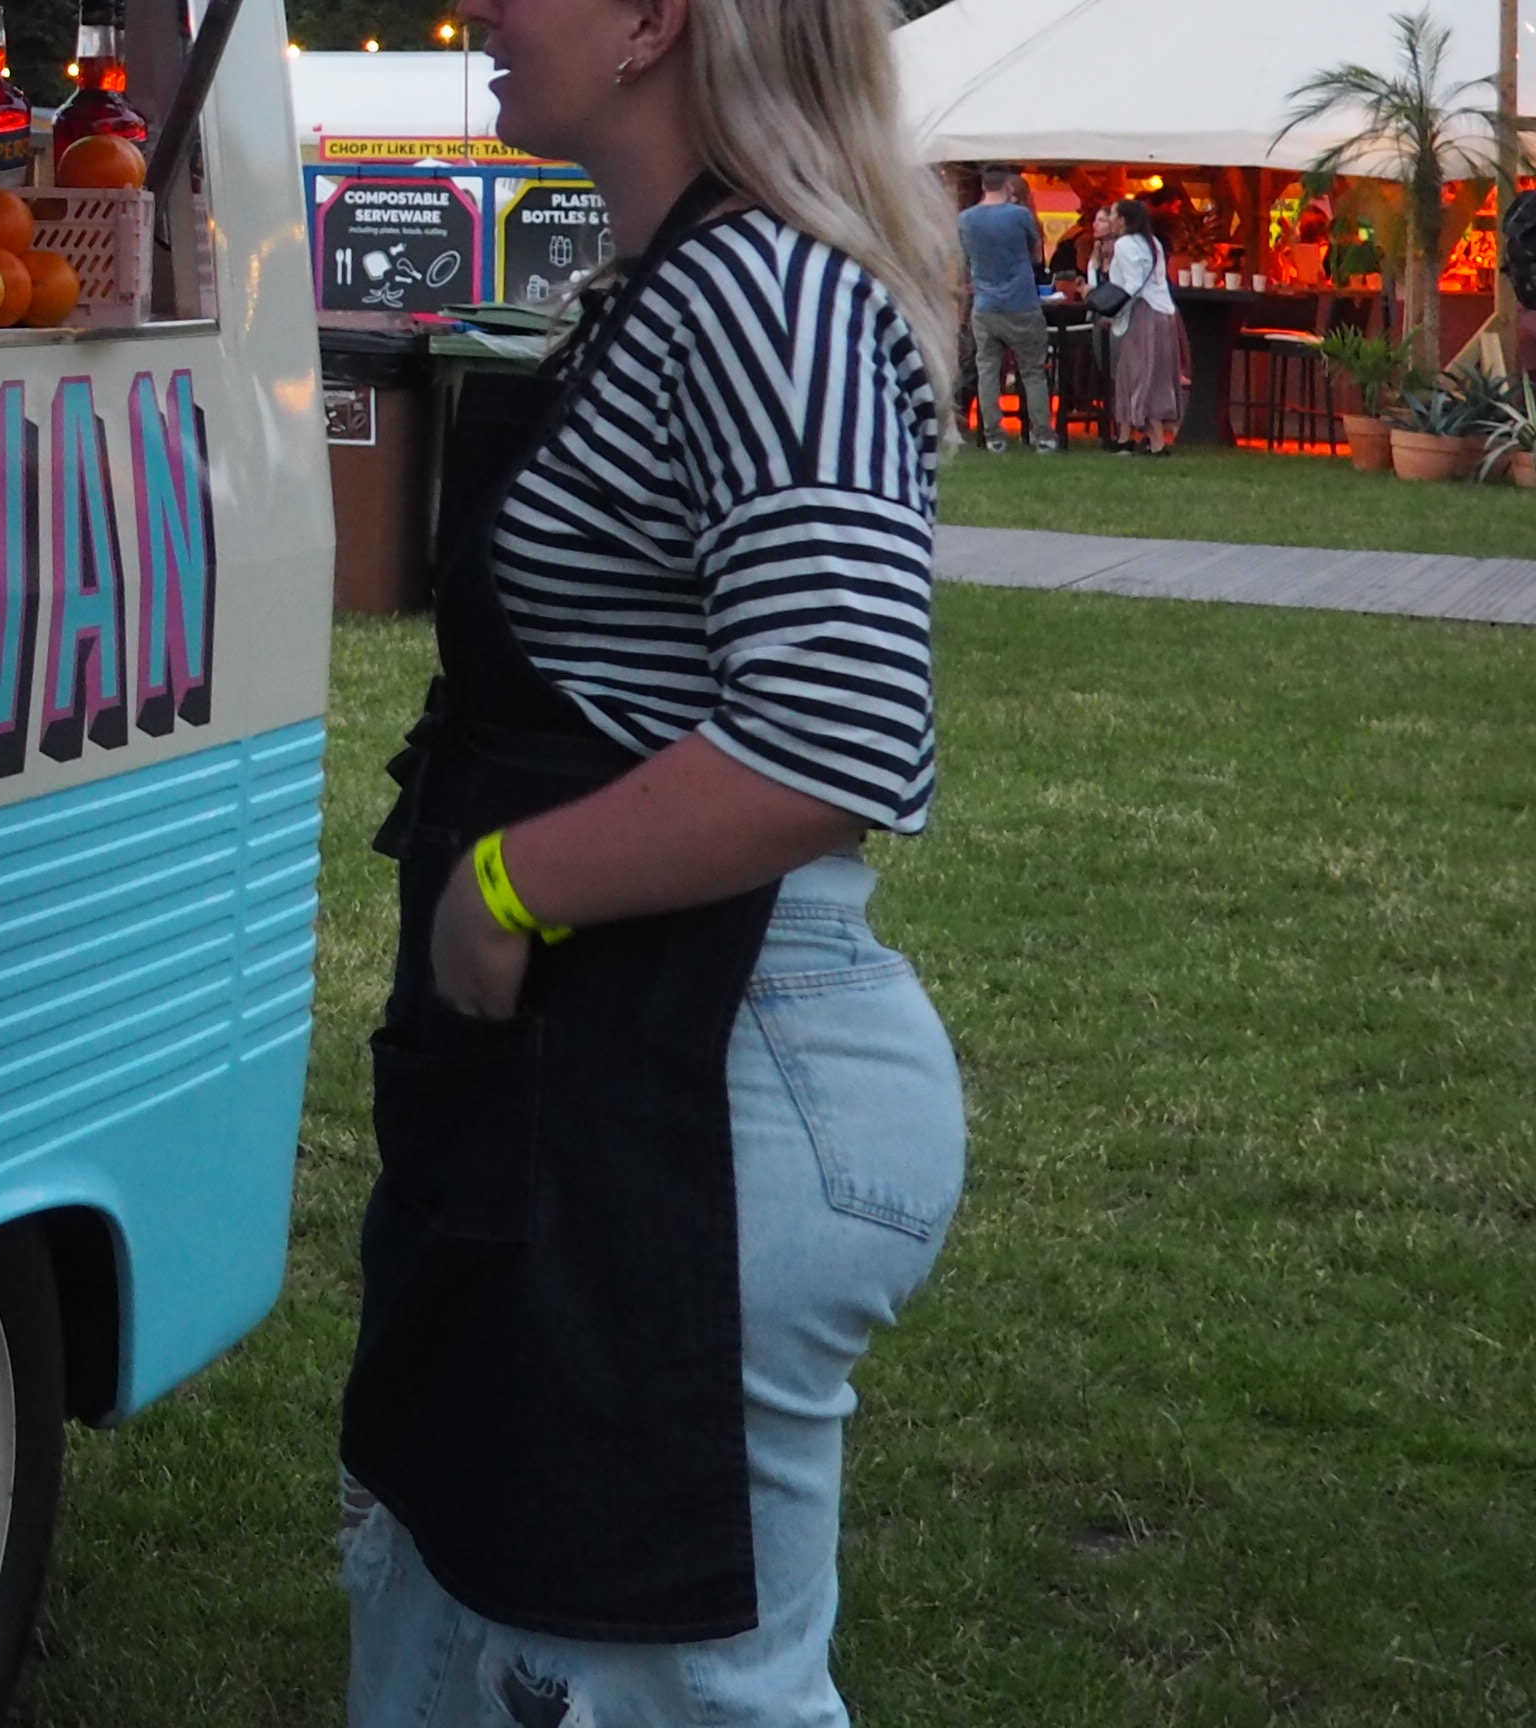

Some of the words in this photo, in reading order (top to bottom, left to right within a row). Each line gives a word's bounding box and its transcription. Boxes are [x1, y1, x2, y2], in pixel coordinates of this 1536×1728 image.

[329, 142, 368, 155] CHOP
[371, 143, 384, 155] IT
[387, 142, 416, 155] LIKE
[419, 143, 444, 155] IT'S
[344, 190, 450, 206] COMPOSTABLE
[551, 193, 606, 208] PLASTI
[354, 208, 442, 224] SERVEWARE
[521, 209, 587, 225] BOTTLES
[588, 212, 600, 225] &
